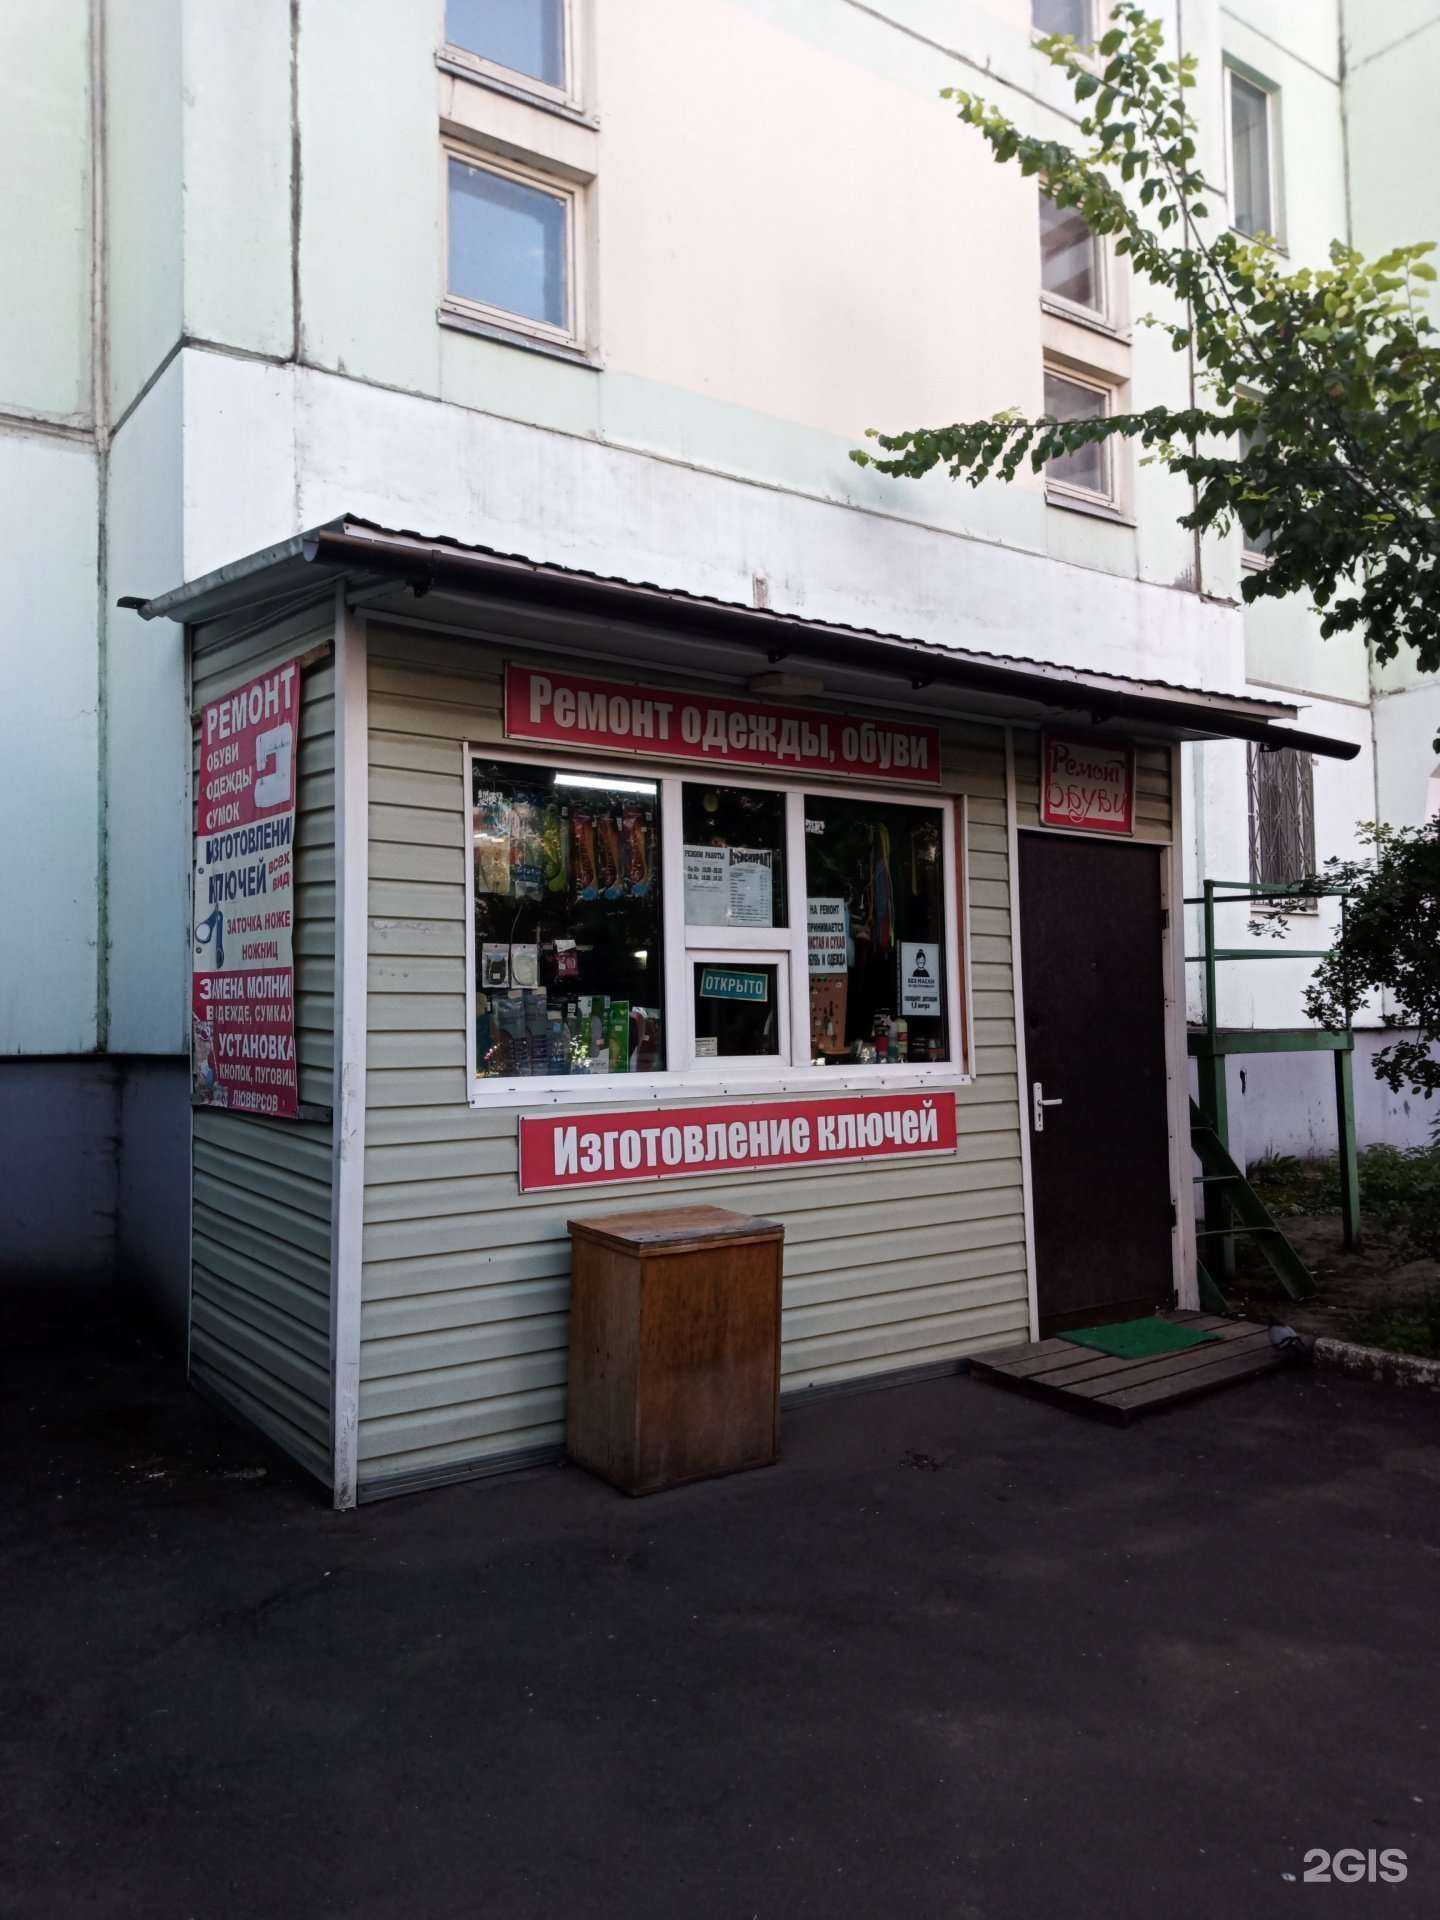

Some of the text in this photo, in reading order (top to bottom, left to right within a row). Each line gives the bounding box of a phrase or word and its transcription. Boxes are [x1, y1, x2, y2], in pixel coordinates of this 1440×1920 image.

[207, 665, 295, 746] РЕМОНТ
[529, 674, 929, 771] Ремонт одежды, обуви
[206, 742, 239, 773] ОБУВИ
[1053, 744, 1125, 783] Ремонт
[206, 765, 252, 803] ОДЕЖДЫ
[206, 804, 240, 830] СУМОК
[206, 815, 292, 865] ИЗГОТОВЛЕНИ
[226, 910, 291, 935] ЗАТОЧКА НОЖЕ
[242, 939, 279, 961] НОЖНИЦ
[247, 974, 292, 1000] МОЛНИ
[704, 975, 763, 994] ОТКРЫТО
[218, 1033, 295, 1061] УСТАНОВКА
[232, 1089, 279, 1112] ЛЮВЕРСОВ
[553, 1099, 939, 1176] Изготовление ключей
